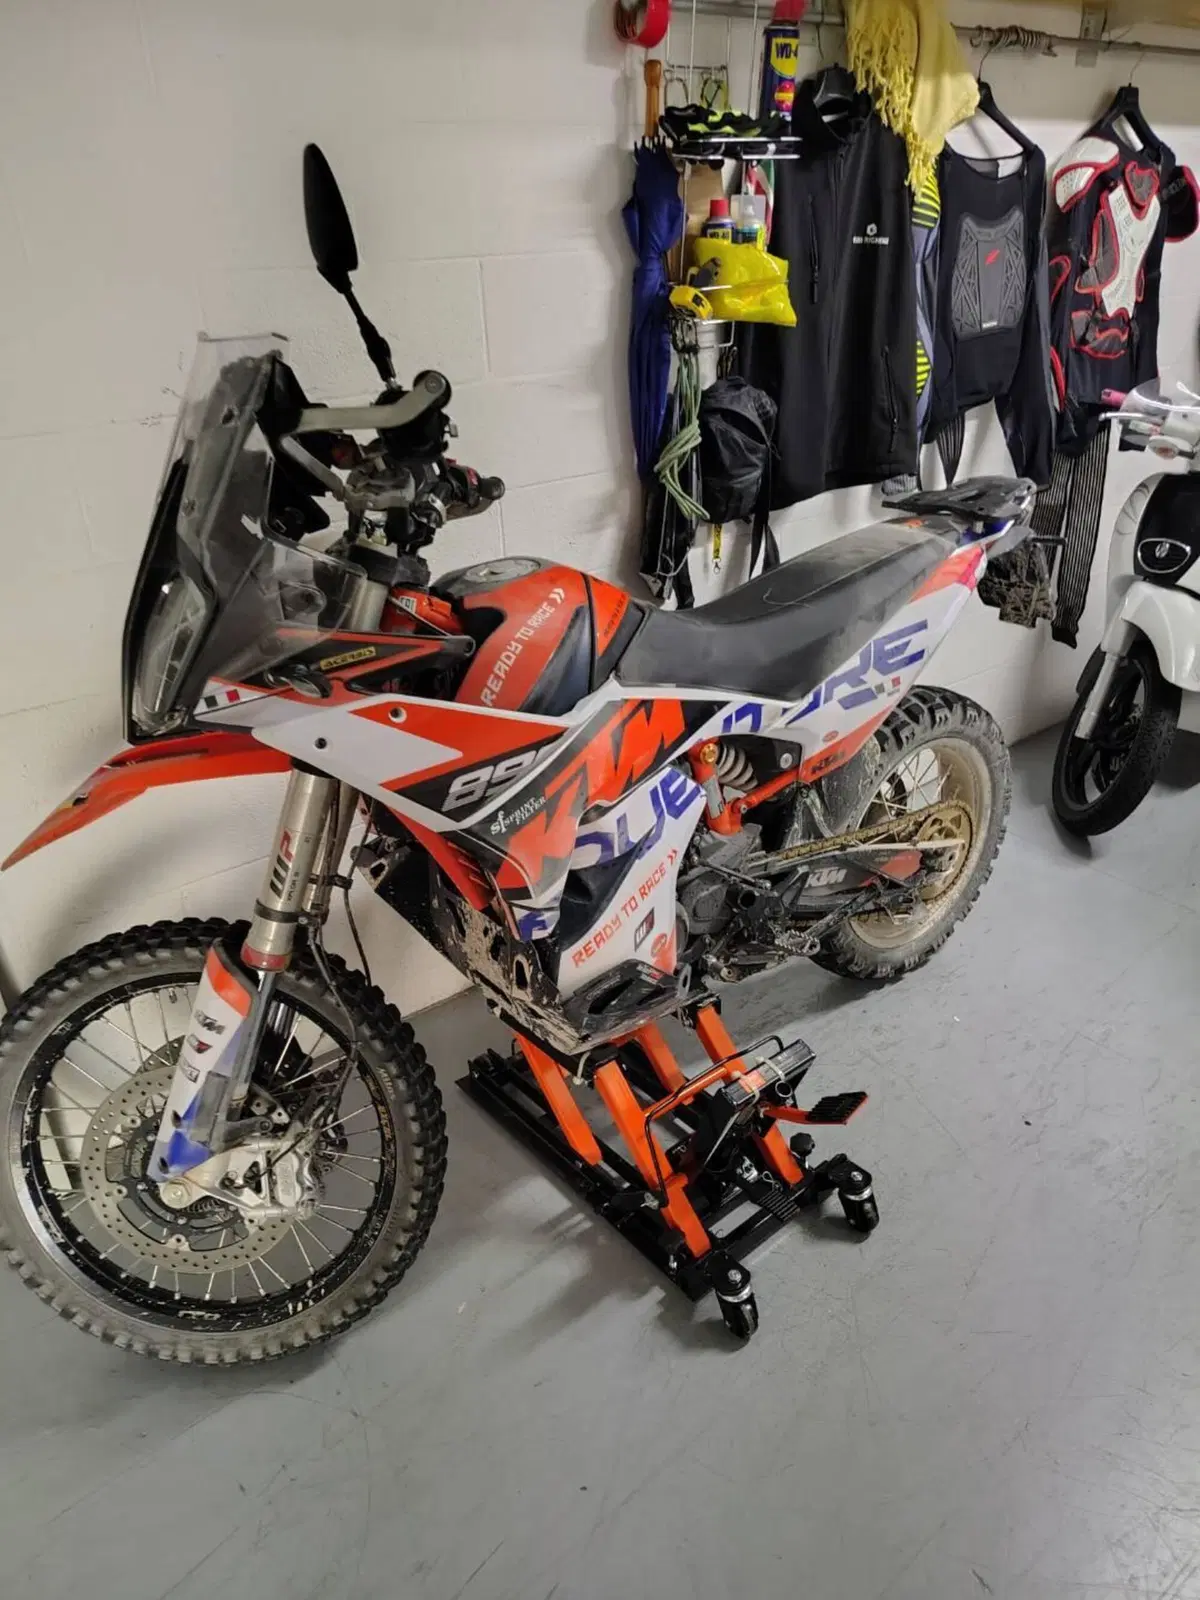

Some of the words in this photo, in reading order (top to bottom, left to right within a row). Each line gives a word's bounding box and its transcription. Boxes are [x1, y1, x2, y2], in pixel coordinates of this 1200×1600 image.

[480, 641, 524, 707] READY
[514, 625, 535, 641] TO
[527, 601, 556, 629] RACE
[496, 697, 686, 890] KTM
[571, 913, 623, 969] READY
[620, 895, 640, 918] TO
[638, 862, 667, 901] RACE
[804, 867, 848, 888] KTM
